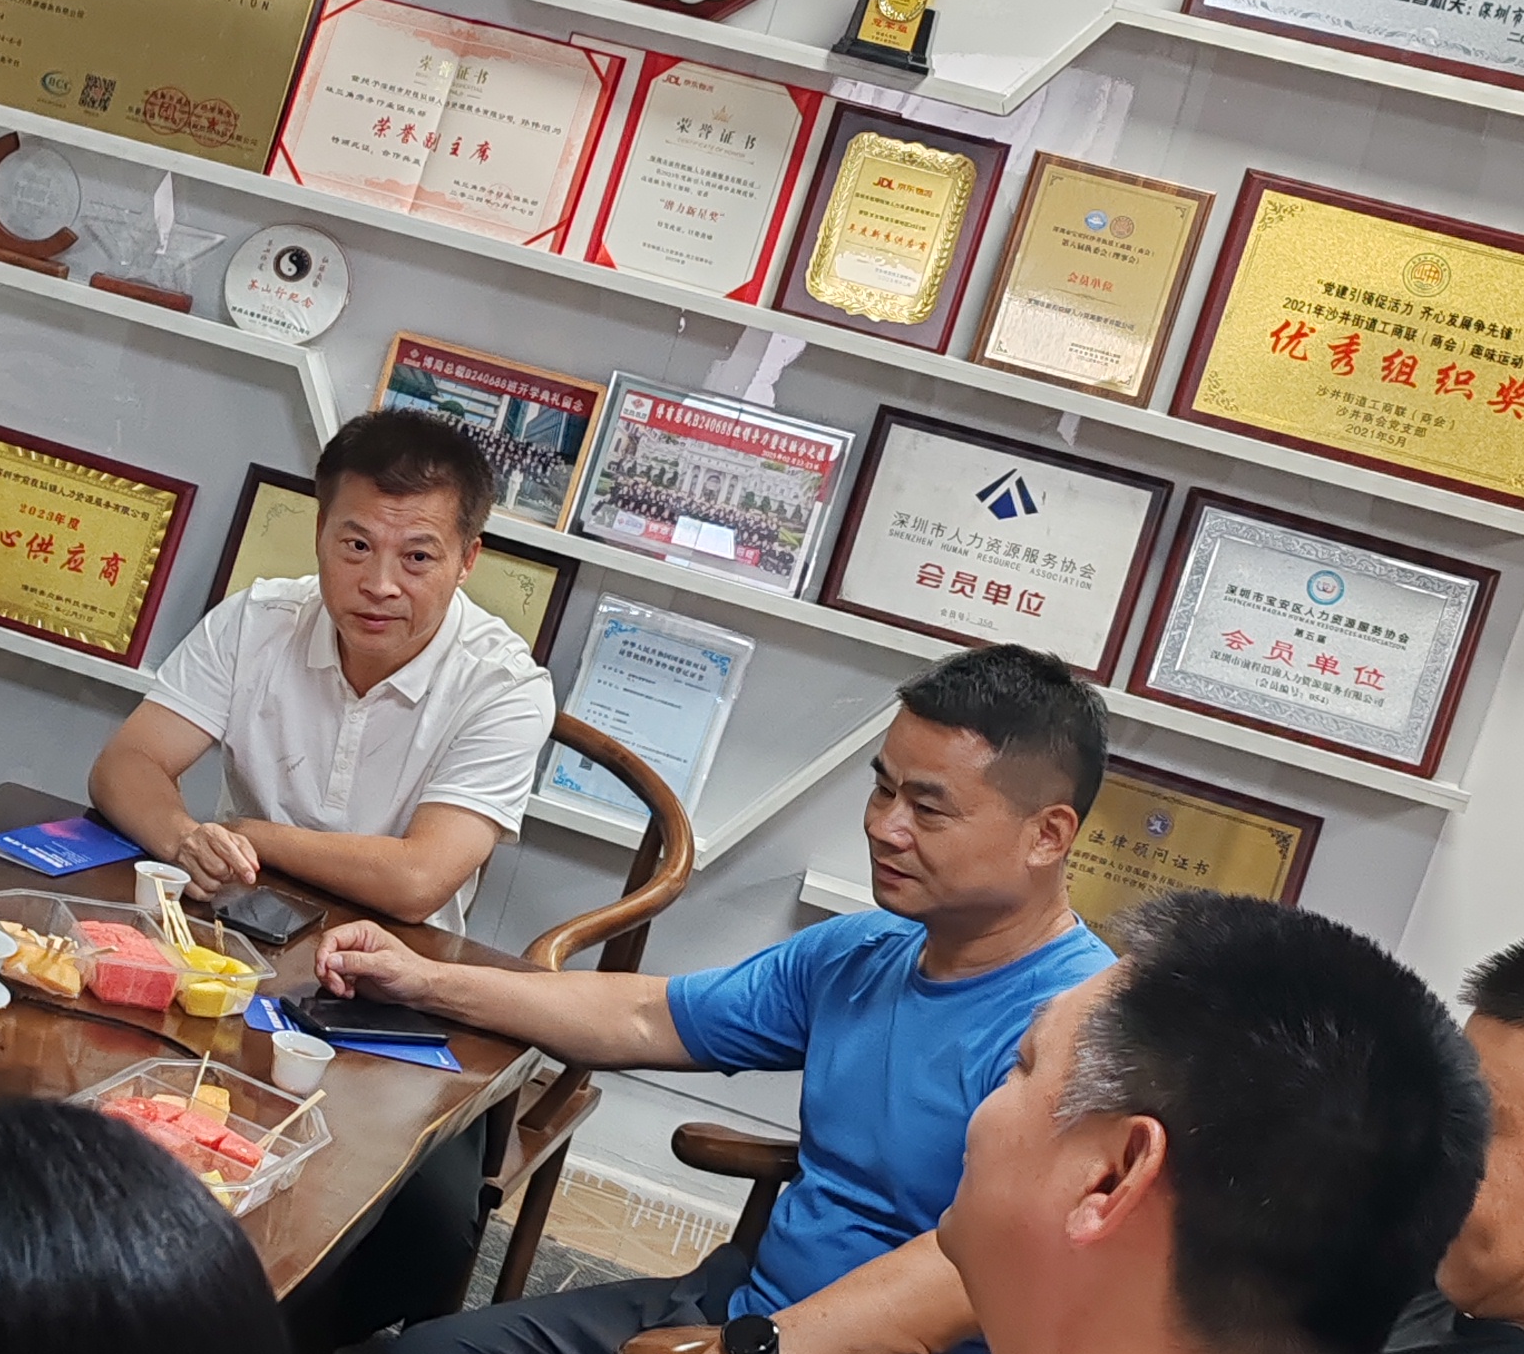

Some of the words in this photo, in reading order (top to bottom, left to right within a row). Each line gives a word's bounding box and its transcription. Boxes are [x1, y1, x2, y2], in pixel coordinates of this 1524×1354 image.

[419, 54, 490, 85] 荣誉证书
[371, 116, 494, 166] 荣誉副主席
[676, 116, 757, 150] 荣誉证书
[872, 175, 895, 191] JDL
[1066, 271, 1114, 293] 会员单位
[1270, 318, 1524, 421] 优秀组织奖
[1344, 423, 1408, 449] 2021年5月
[18, 502, 81, 532] 2023年度
[888, 528, 933, 547] SHENZHEN
[940, 544, 970, 558] HUMAN
[976, 553, 1022, 572] RESOURCE
[1029, 567, 1093, 591] ASSOCIATION
[891, 510, 1097, 581] 深圳市人力资源服务协会
[915, 561, 1046, 618] 会员单位
[1224, 582, 1411, 645] 深圳市宝安区人力资源服务协会
[1221, 629, 1386, 692] 会员单位
[1087, 828, 1210, 877] 法律顾问证书
